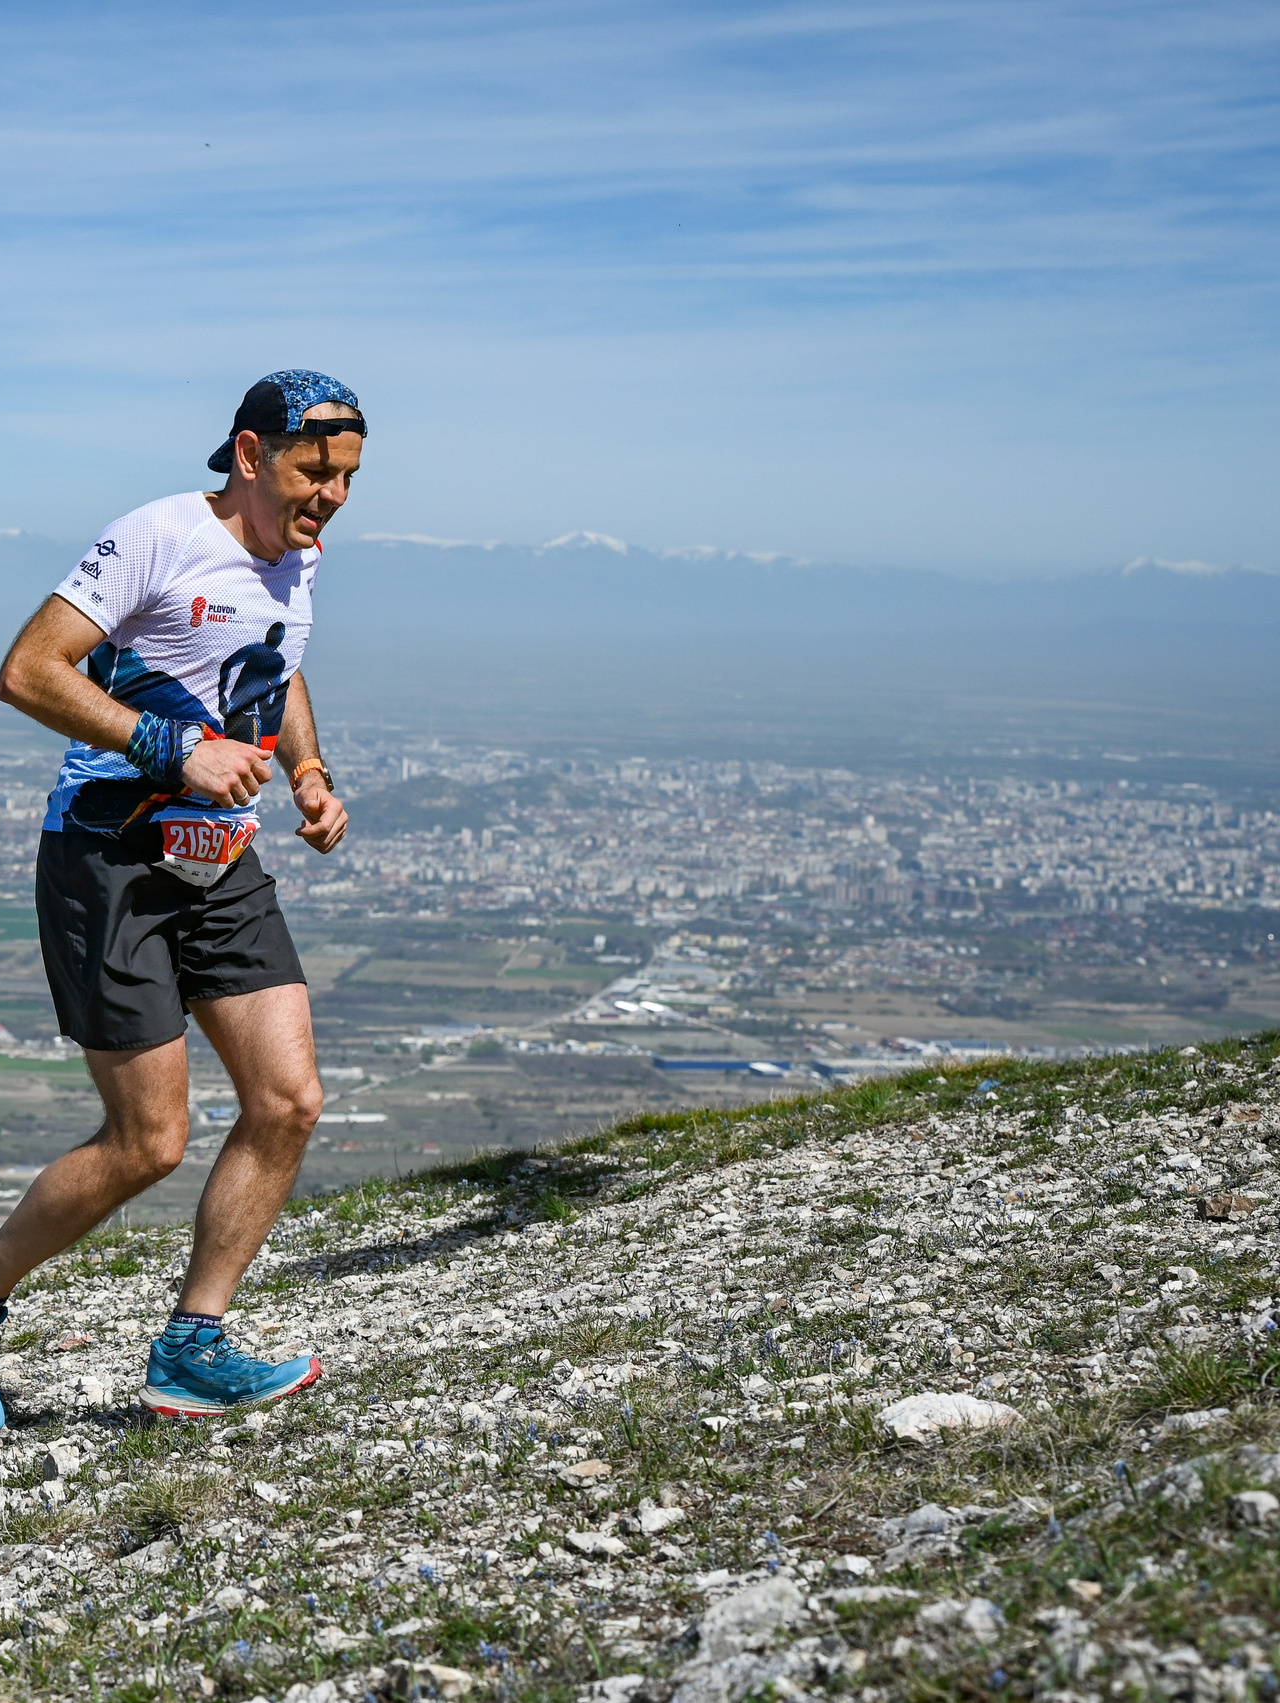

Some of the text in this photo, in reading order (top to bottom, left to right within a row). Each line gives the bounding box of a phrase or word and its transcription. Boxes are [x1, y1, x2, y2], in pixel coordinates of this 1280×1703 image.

[208, 604, 237, 614] PLOVDIV
[207, 613, 227, 623] HILLS
[169, 825, 225, 860] 2169
